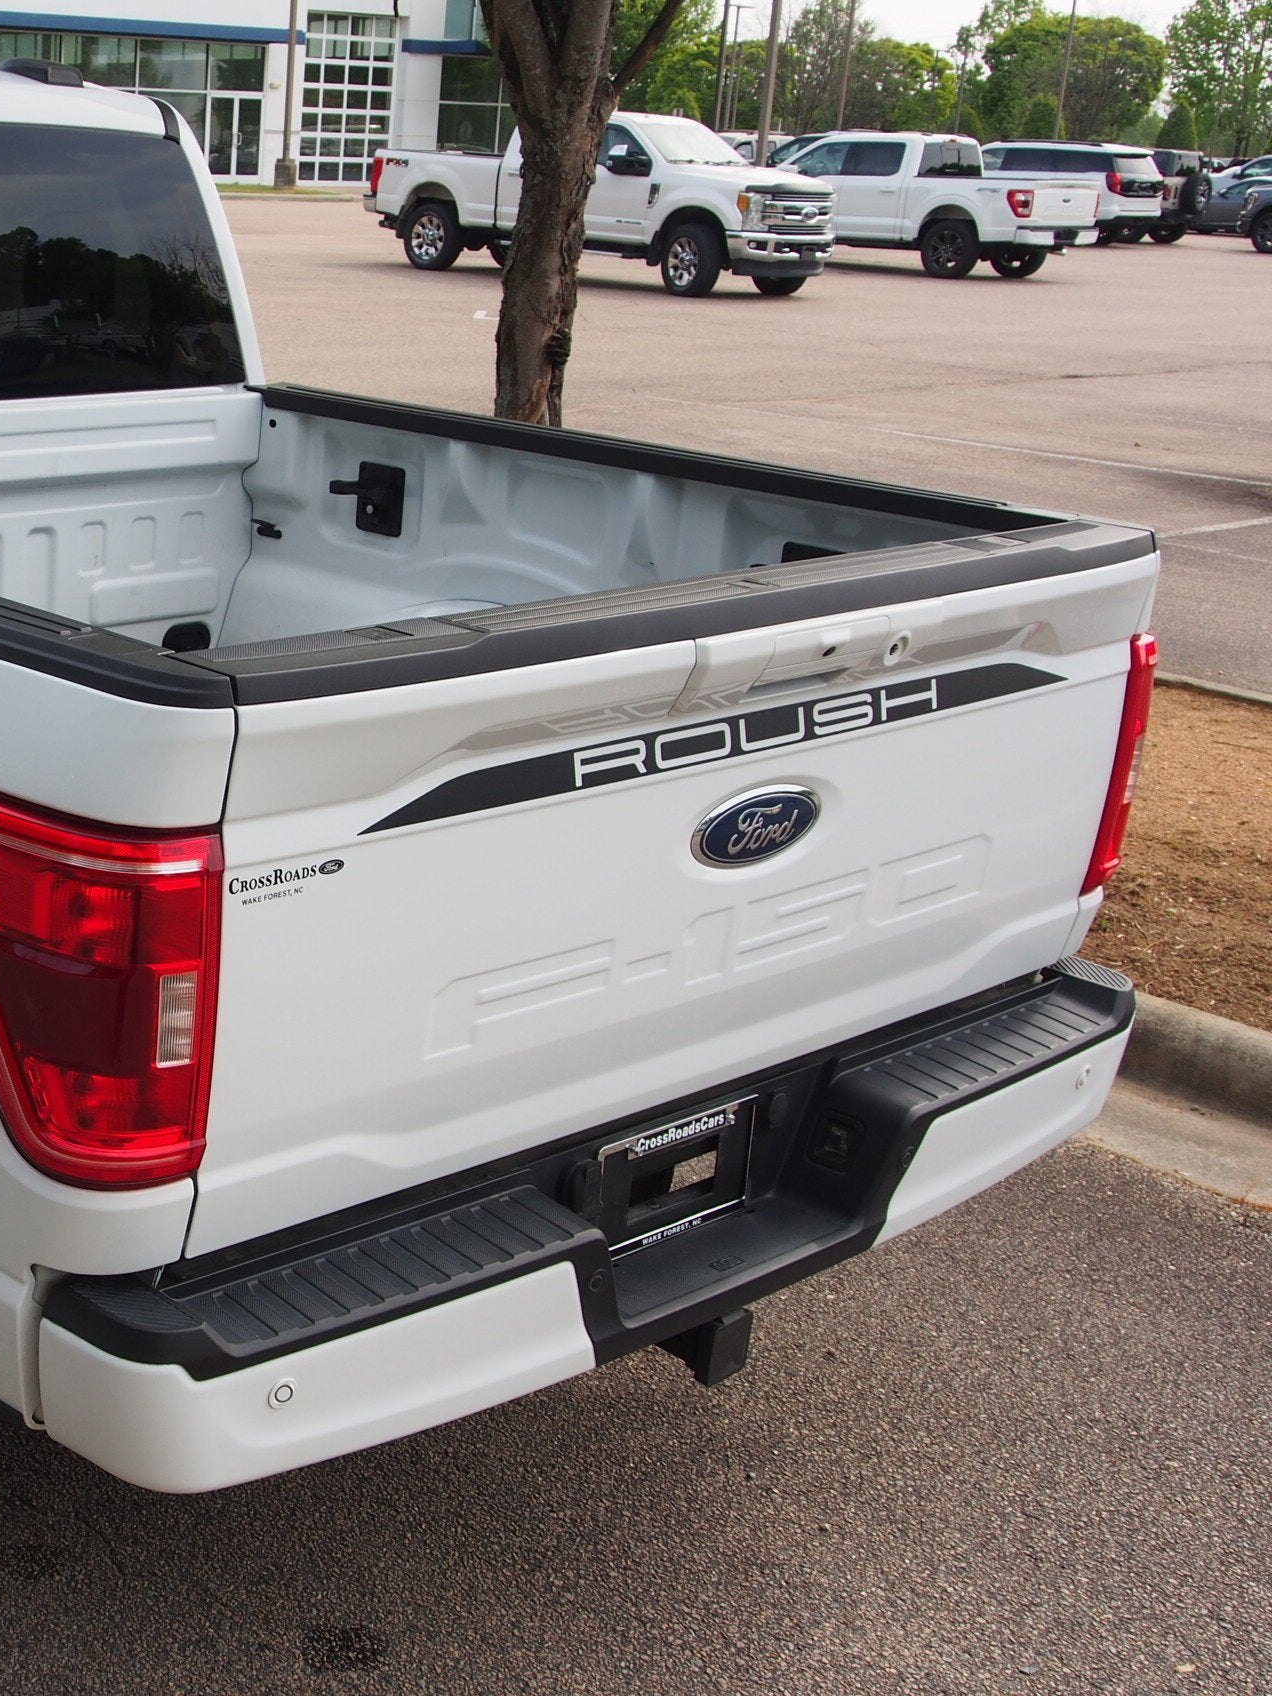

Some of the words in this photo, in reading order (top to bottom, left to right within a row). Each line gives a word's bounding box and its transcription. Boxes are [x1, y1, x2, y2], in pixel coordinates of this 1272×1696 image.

[573, 678, 937, 787] ROUSH
[727, 803, 799, 855] Ford
[241, 895, 262, 906] WAKE
[263, 889, 293, 901] FOREST,
[294, 886, 304, 894] NC
[424, 833, 993, 1061] F-150
[636, 1113, 725, 1152] CrossRoadsCars
[642, 1232, 662, 1246] WAKE
[663, 1223, 691, 1237] FOREST,
[692, 1218, 703, 1227] NC
